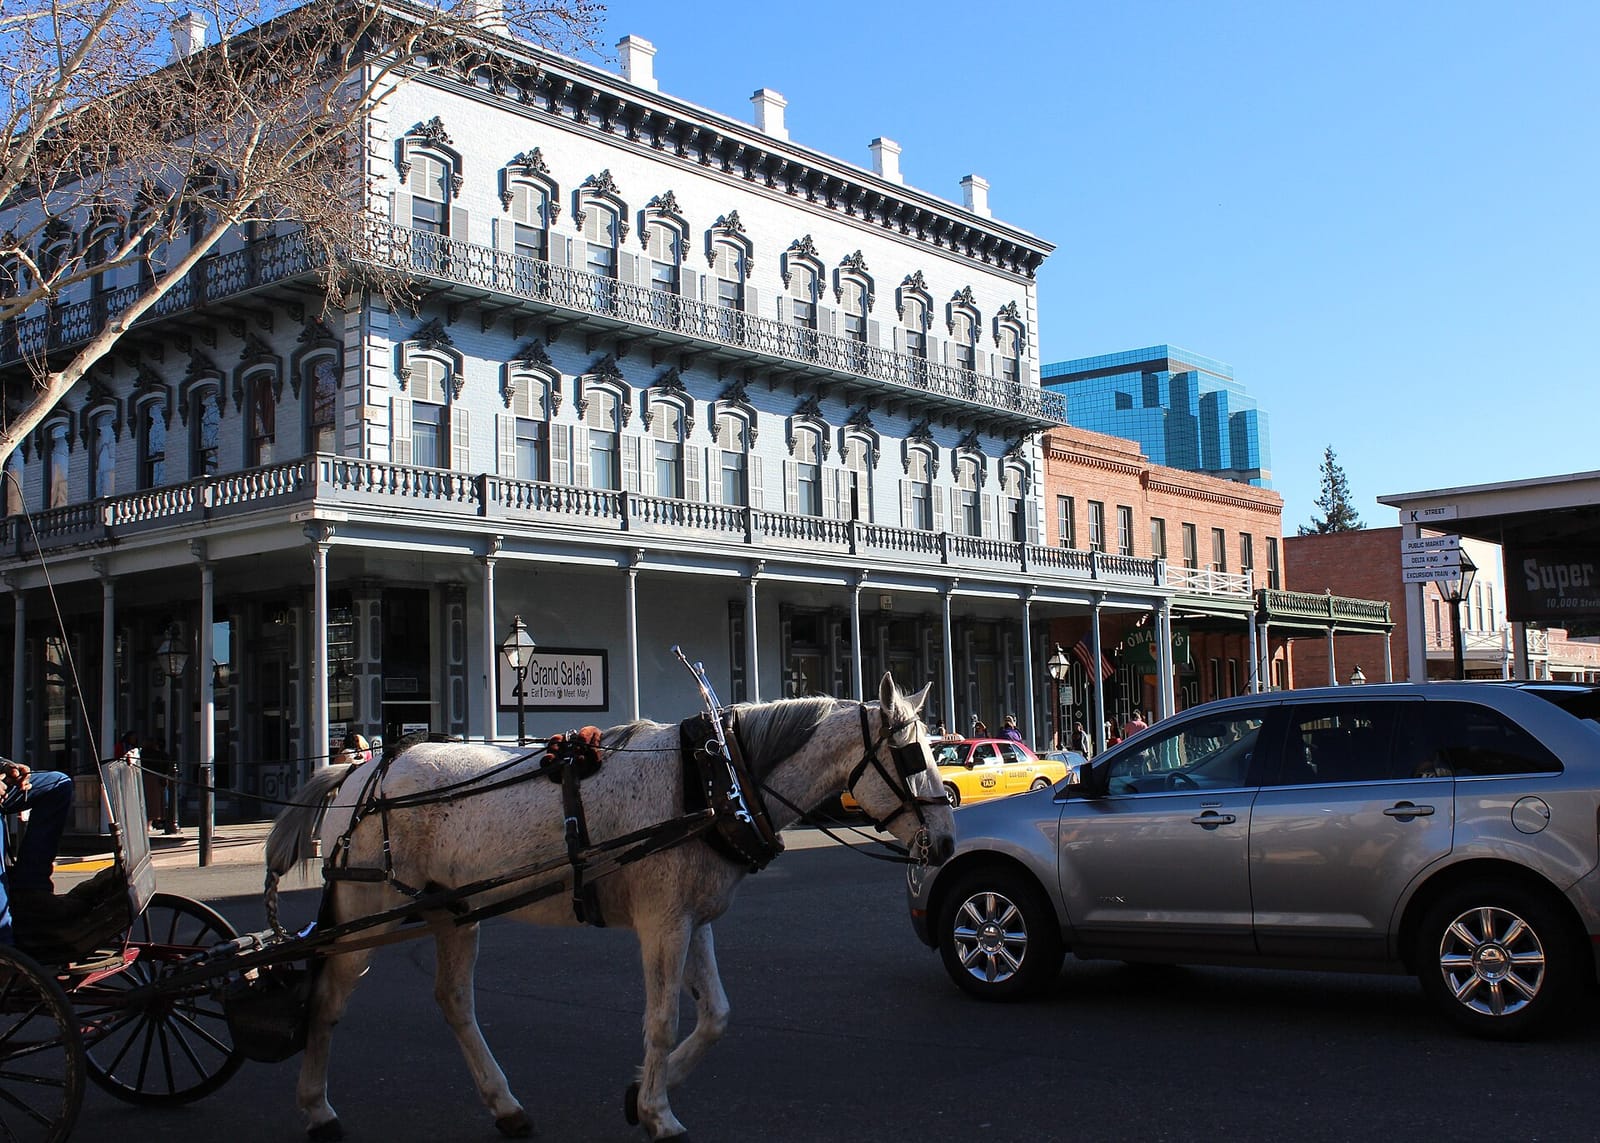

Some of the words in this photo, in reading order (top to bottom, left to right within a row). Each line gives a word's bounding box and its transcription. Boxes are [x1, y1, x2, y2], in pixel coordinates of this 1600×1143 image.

[1410, 511, 1418, 521] K
[1424, 508, 1445, 516] STREET
[1408, 542, 1424, 550] PUBLIC
[1425, 540, 1445, 548] MARKET
[1426, 555, 1439, 563] KING
[1406, 571, 1433, 579] EXCURSION
[1523, 558, 1593, 597] Super
[531, 659, 559, 686] Grand
[531, 688, 540, 697] Eat
